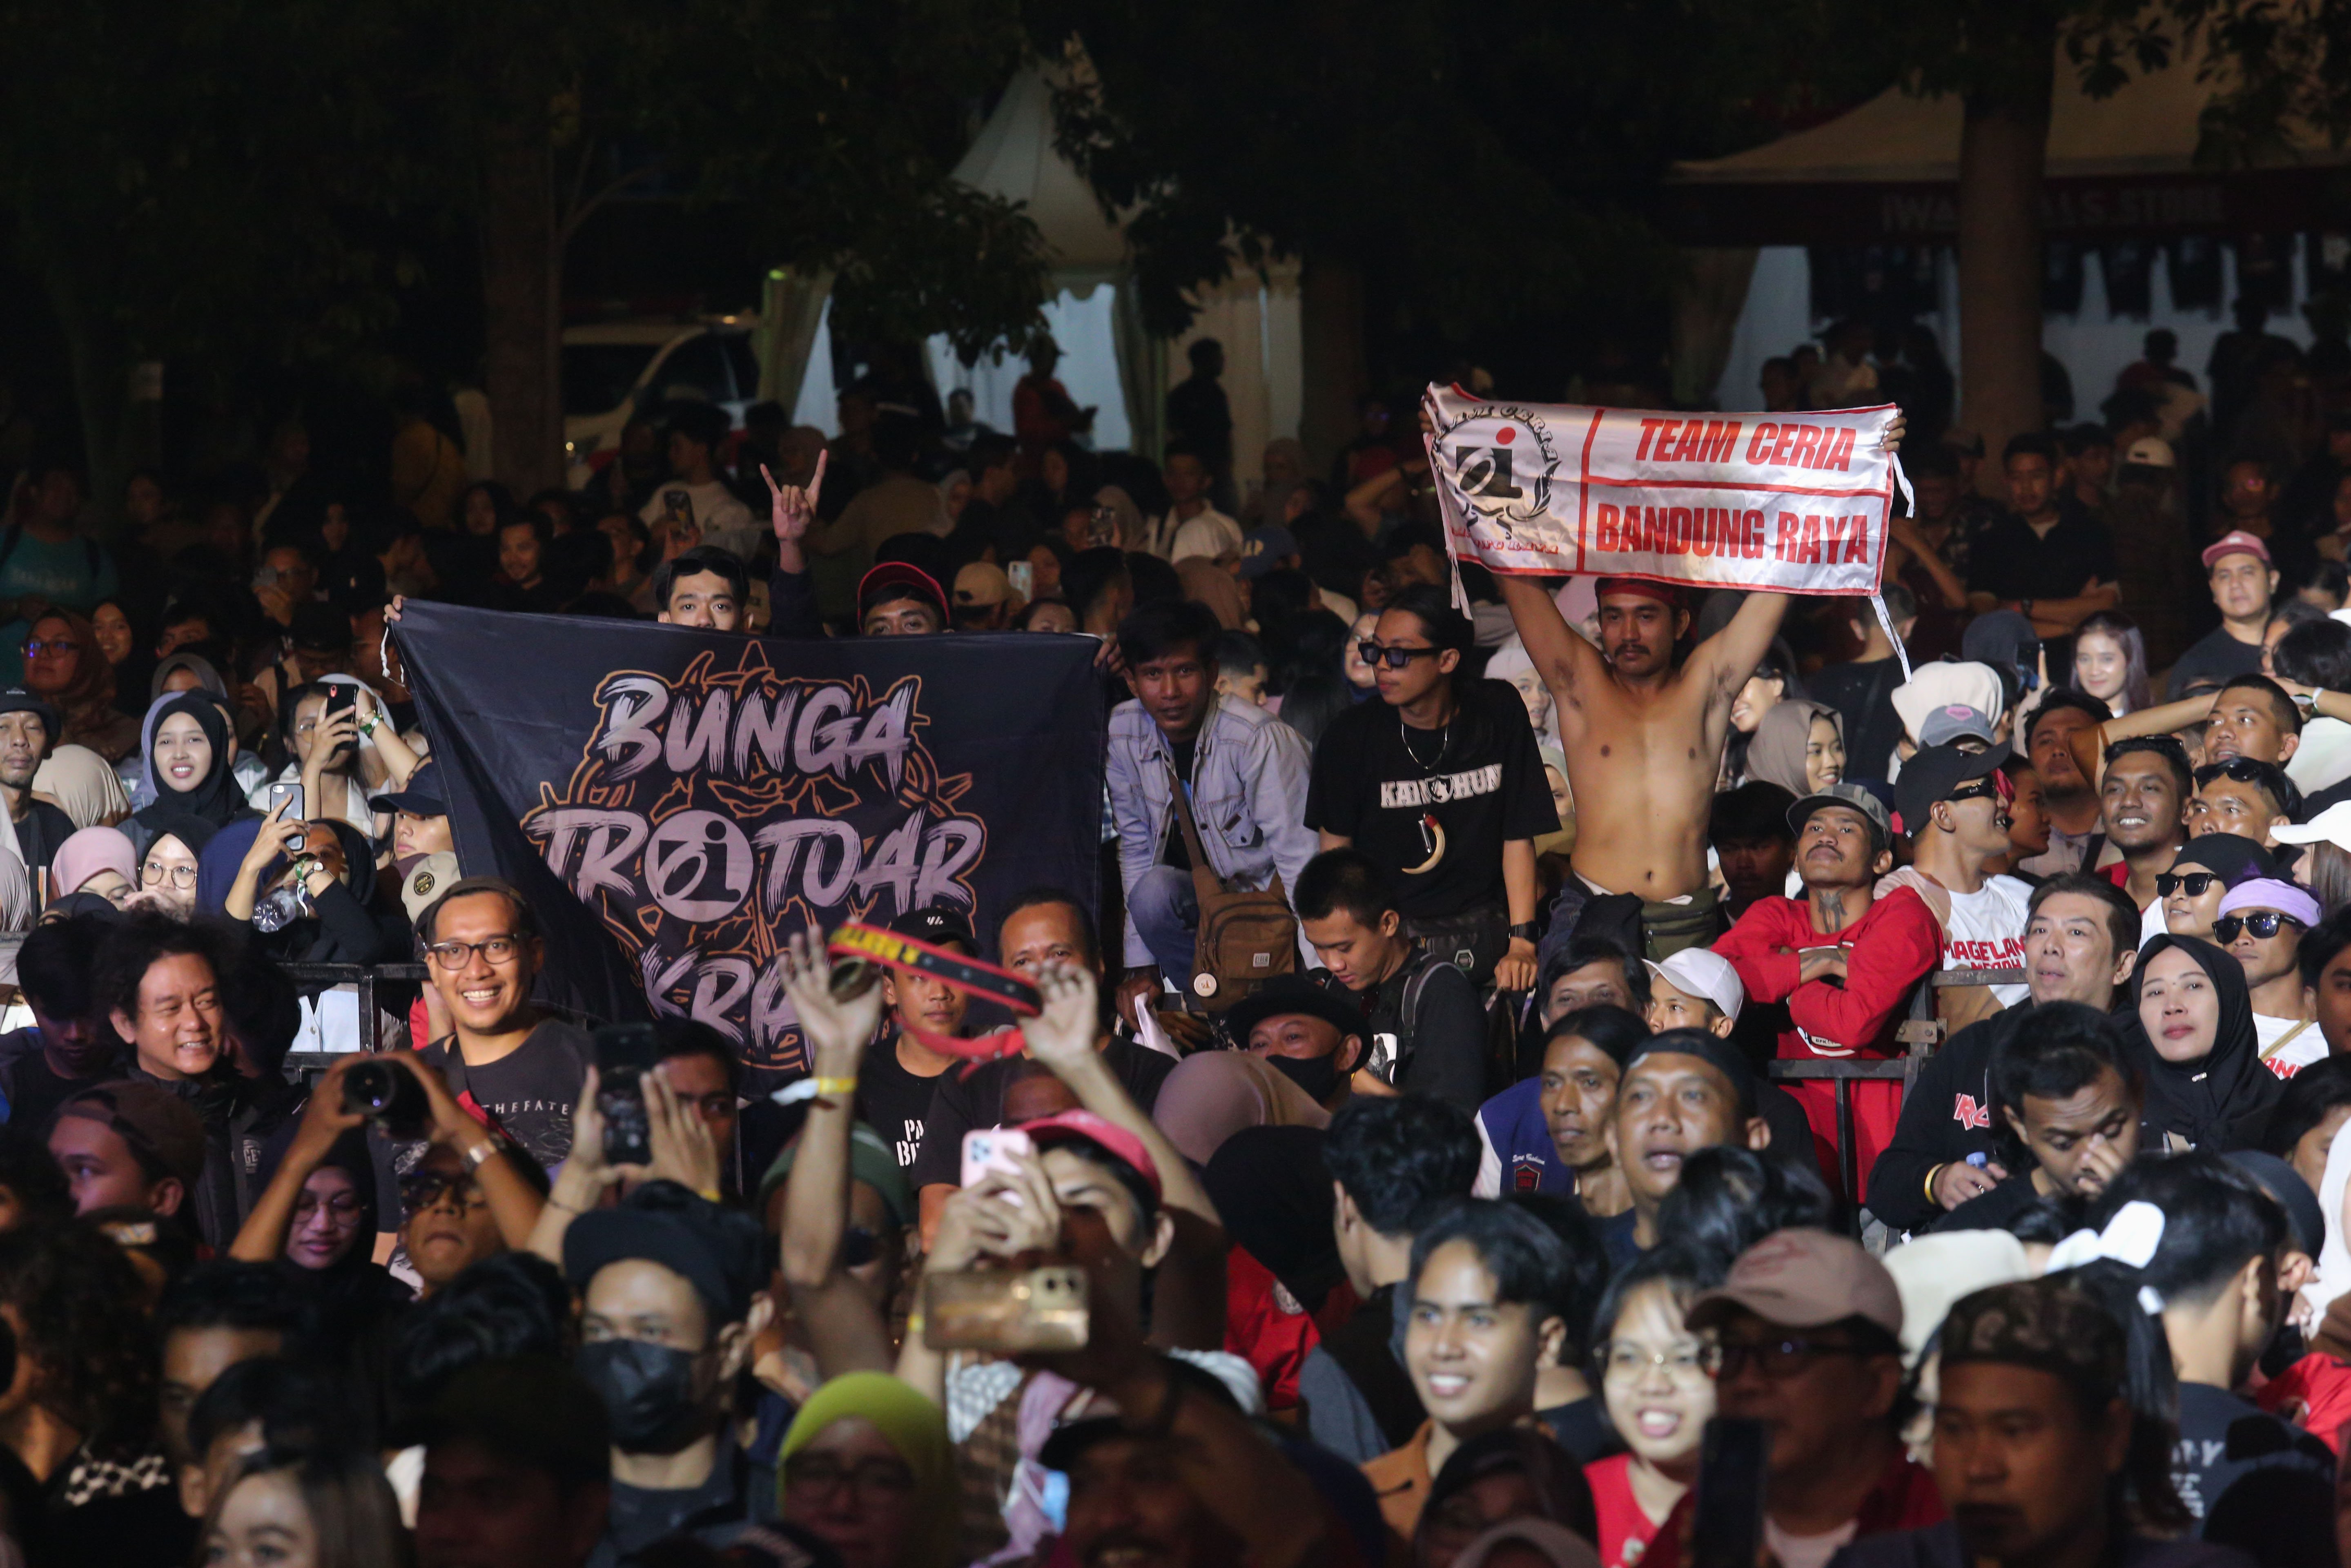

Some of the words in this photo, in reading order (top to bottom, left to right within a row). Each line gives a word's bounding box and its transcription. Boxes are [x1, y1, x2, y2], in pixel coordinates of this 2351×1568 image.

[1635, 418, 1743, 463] TEAM
[1745, 422, 1856, 472] CERIA
[1596, 503, 1765, 559] BANDUNG
[1775, 511, 1868, 564] RAYA
[597, 677, 919, 797] BUNGA
[1944, 935, 2026, 961] MAGELAN
